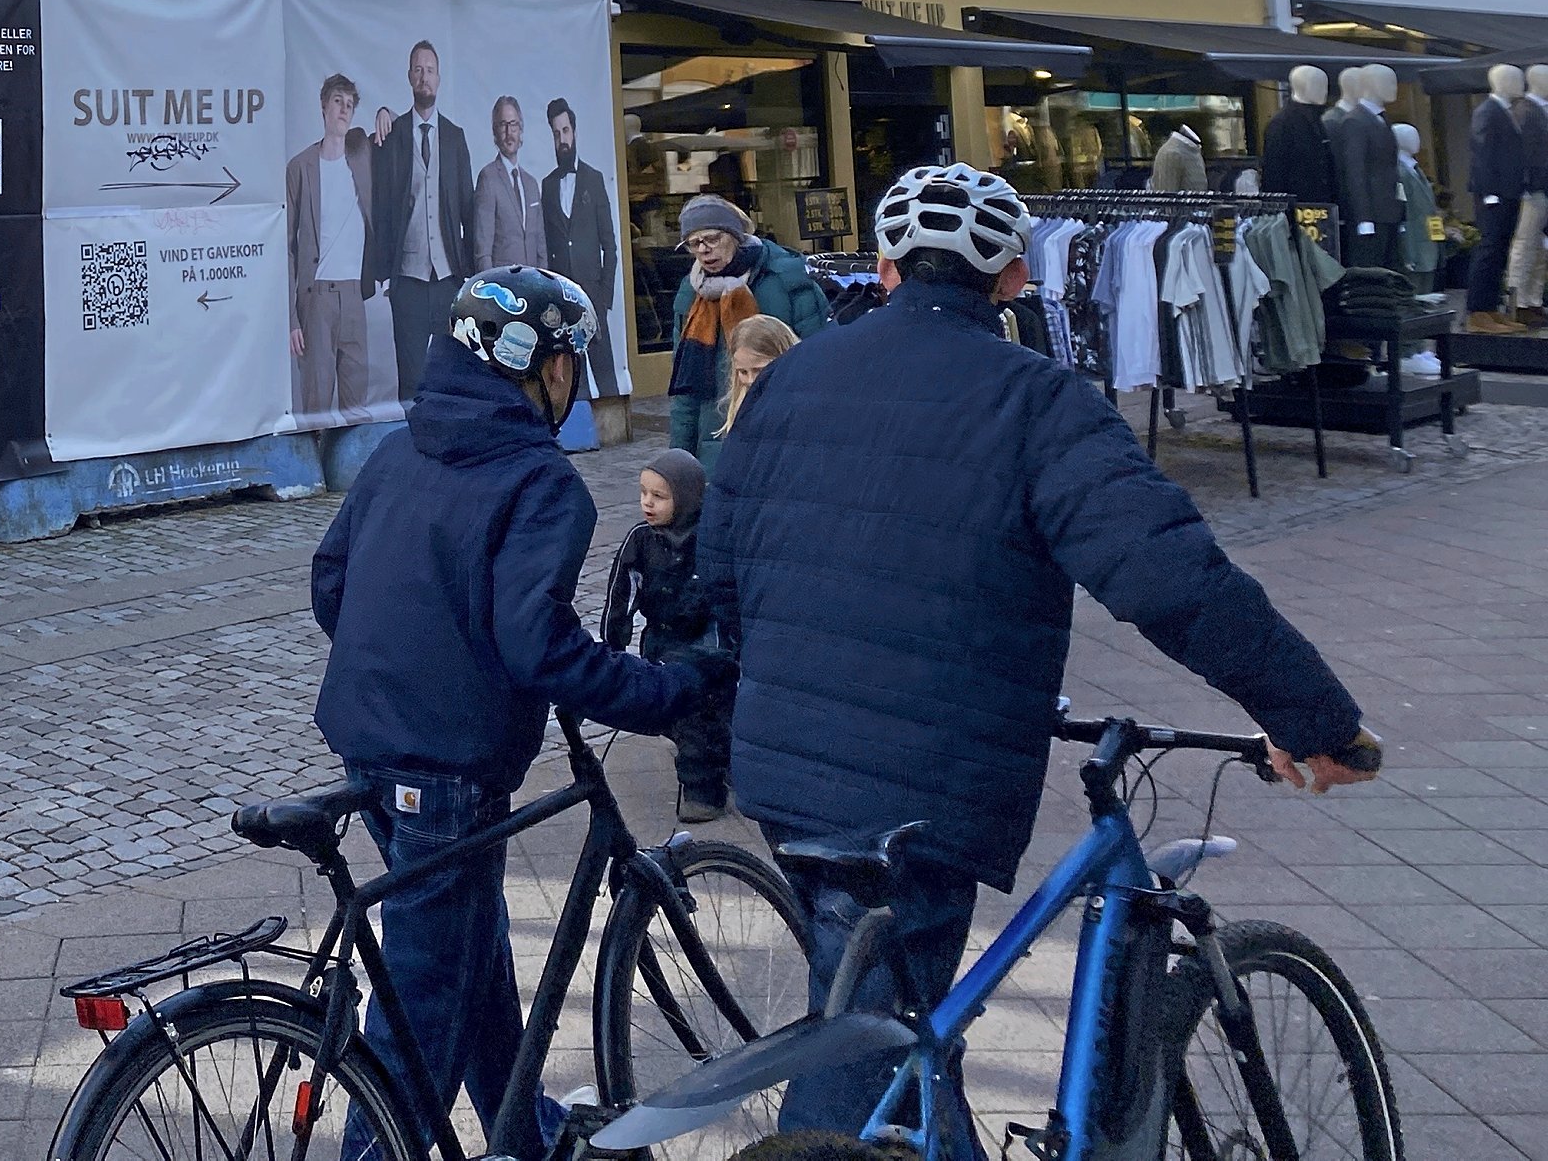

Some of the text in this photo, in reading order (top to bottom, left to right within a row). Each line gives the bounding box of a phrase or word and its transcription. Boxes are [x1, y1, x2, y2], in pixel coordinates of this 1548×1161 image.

[1, 28, 32, 39] ELLER
[16, 44, 35, 55] FOR
[73, 89, 265, 126] SUIT ME UP
[160, 243, 264, 262] VIND ET GAVEKORT
[182, 266, 247, 282] PÅ 1.000KR.
